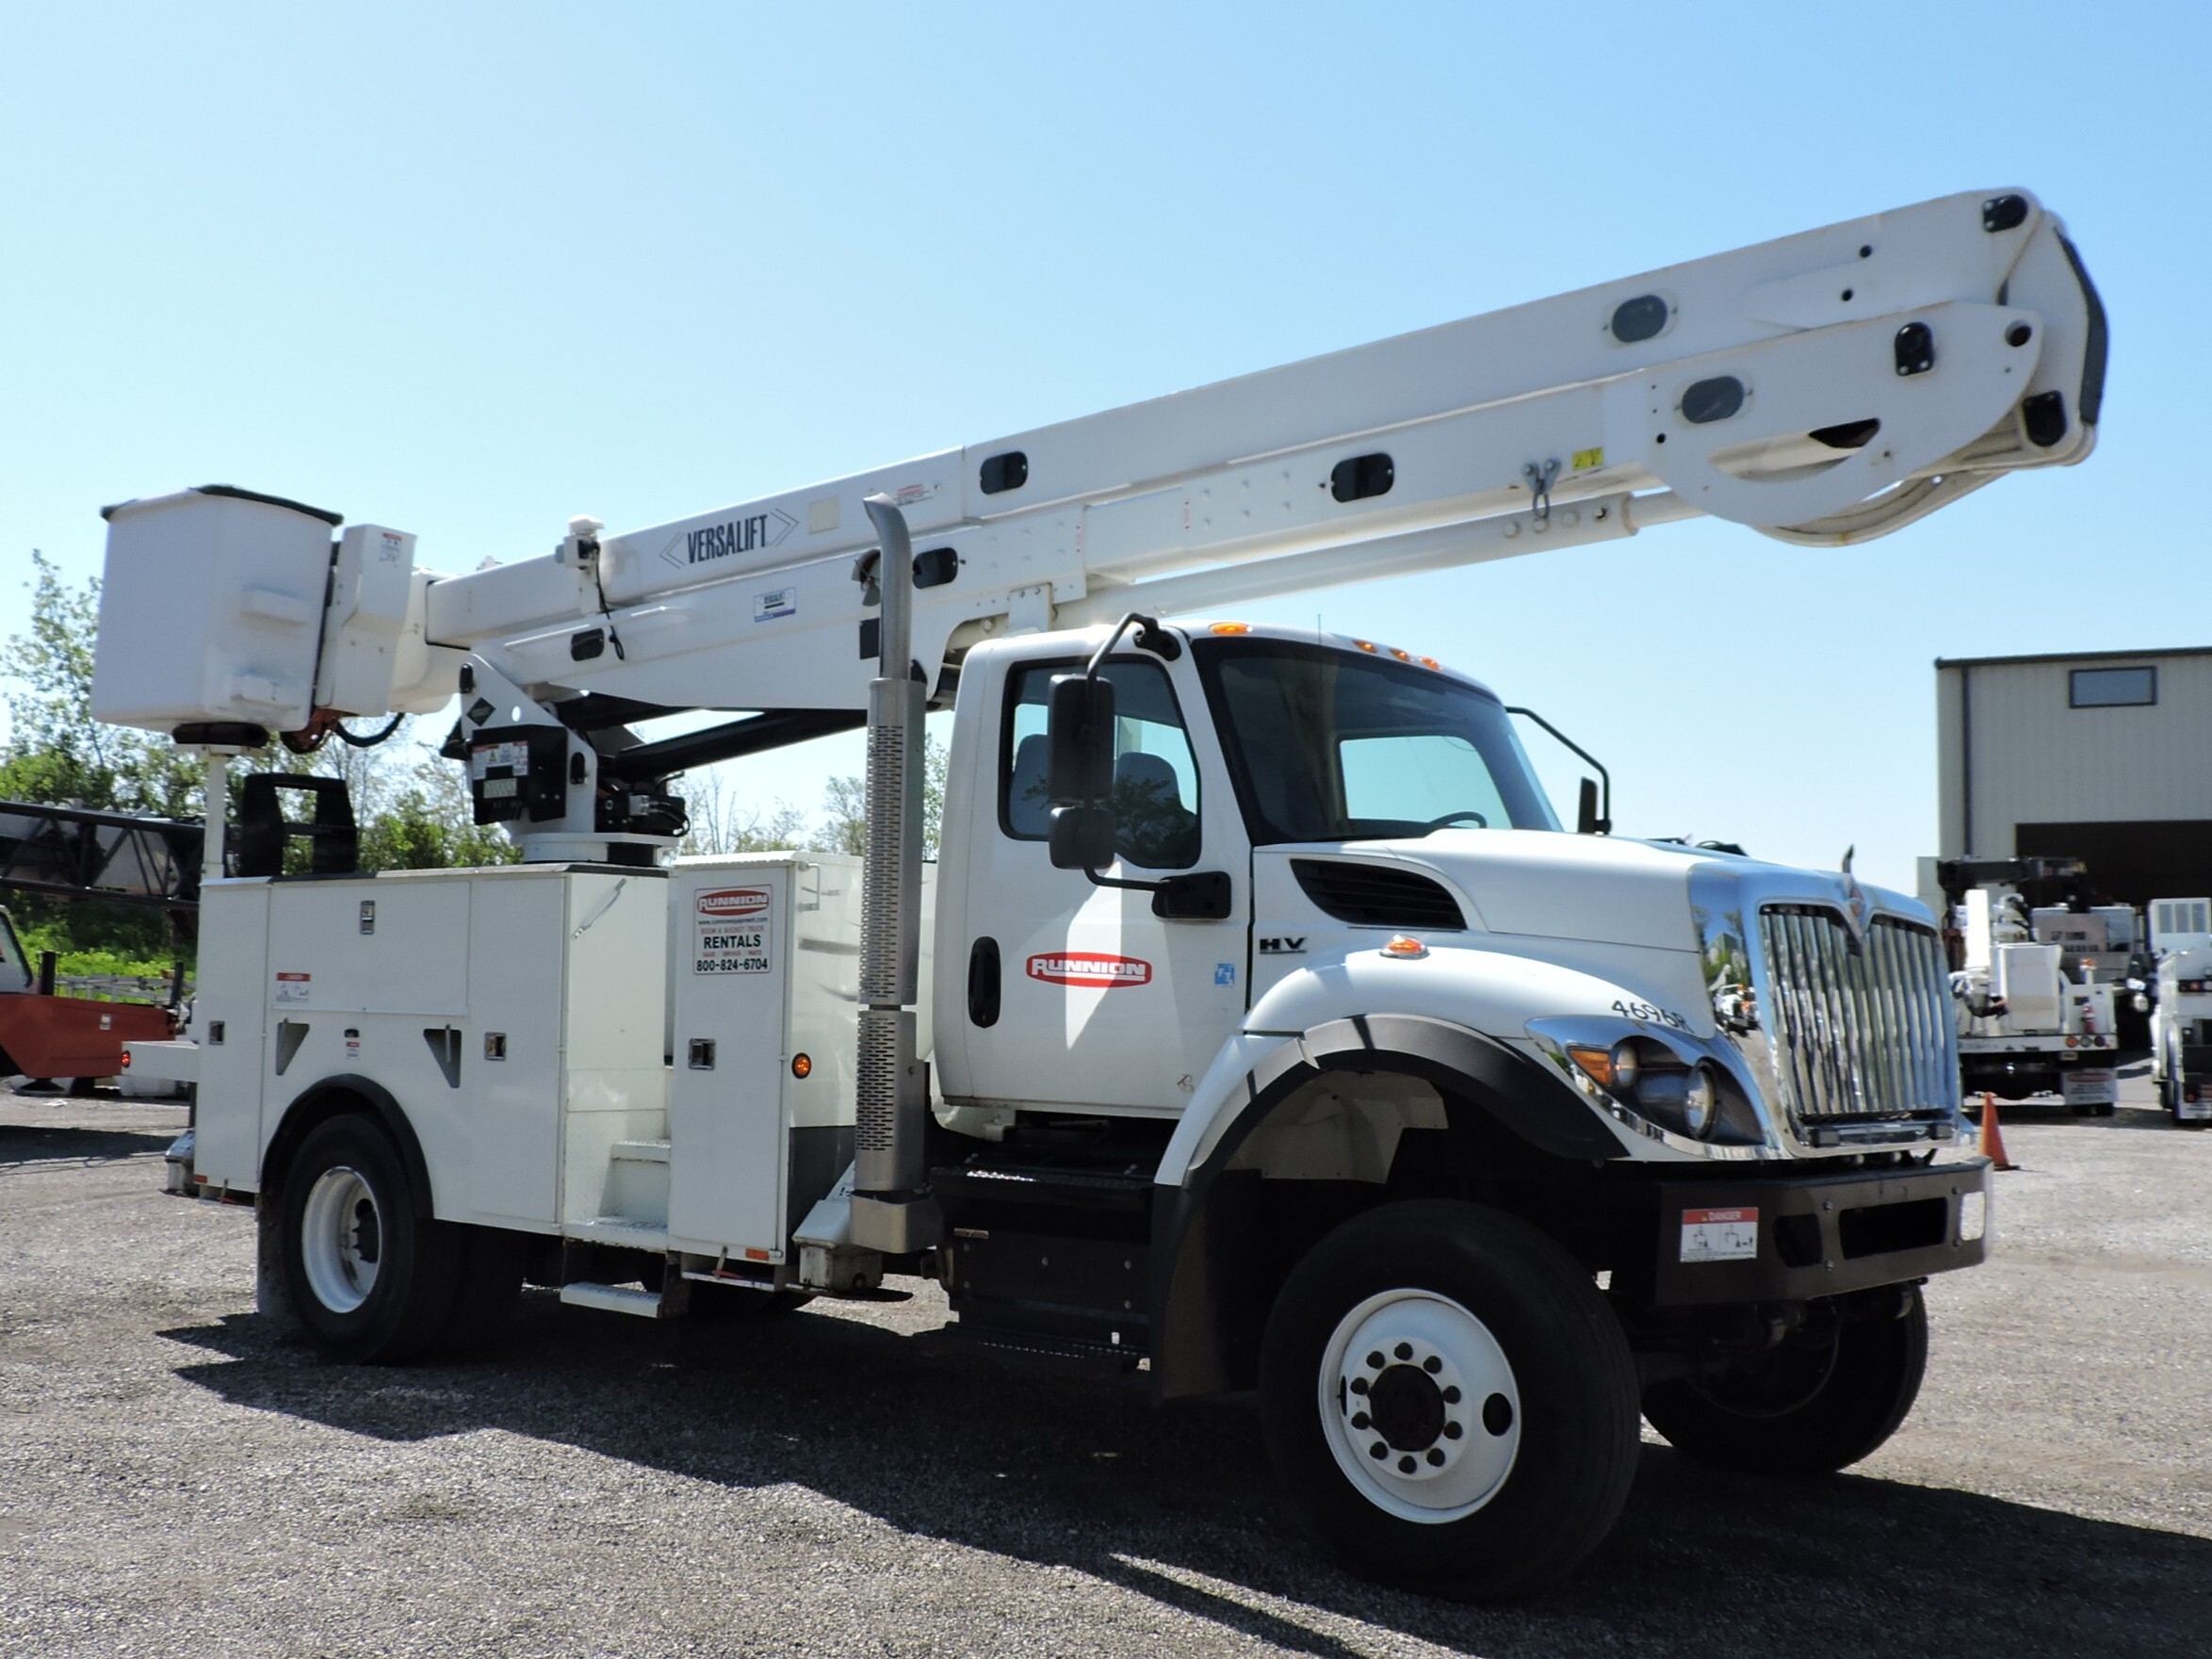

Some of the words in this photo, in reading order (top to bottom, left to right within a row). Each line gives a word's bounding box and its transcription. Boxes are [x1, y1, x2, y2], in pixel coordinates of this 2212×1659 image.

[688, 514, 768, 564] VERSALIFT
[699, 895, 767, 911] RUNNION
[704, 935, 761, 949] RENTALS
[1259, 936, 1306, 953] HV
[696, 958, 768, 970] 800-824-6704
[1032, 958, 1147, 982] RUNNION
[1611, 1000, 1695, 1034] 4696R
